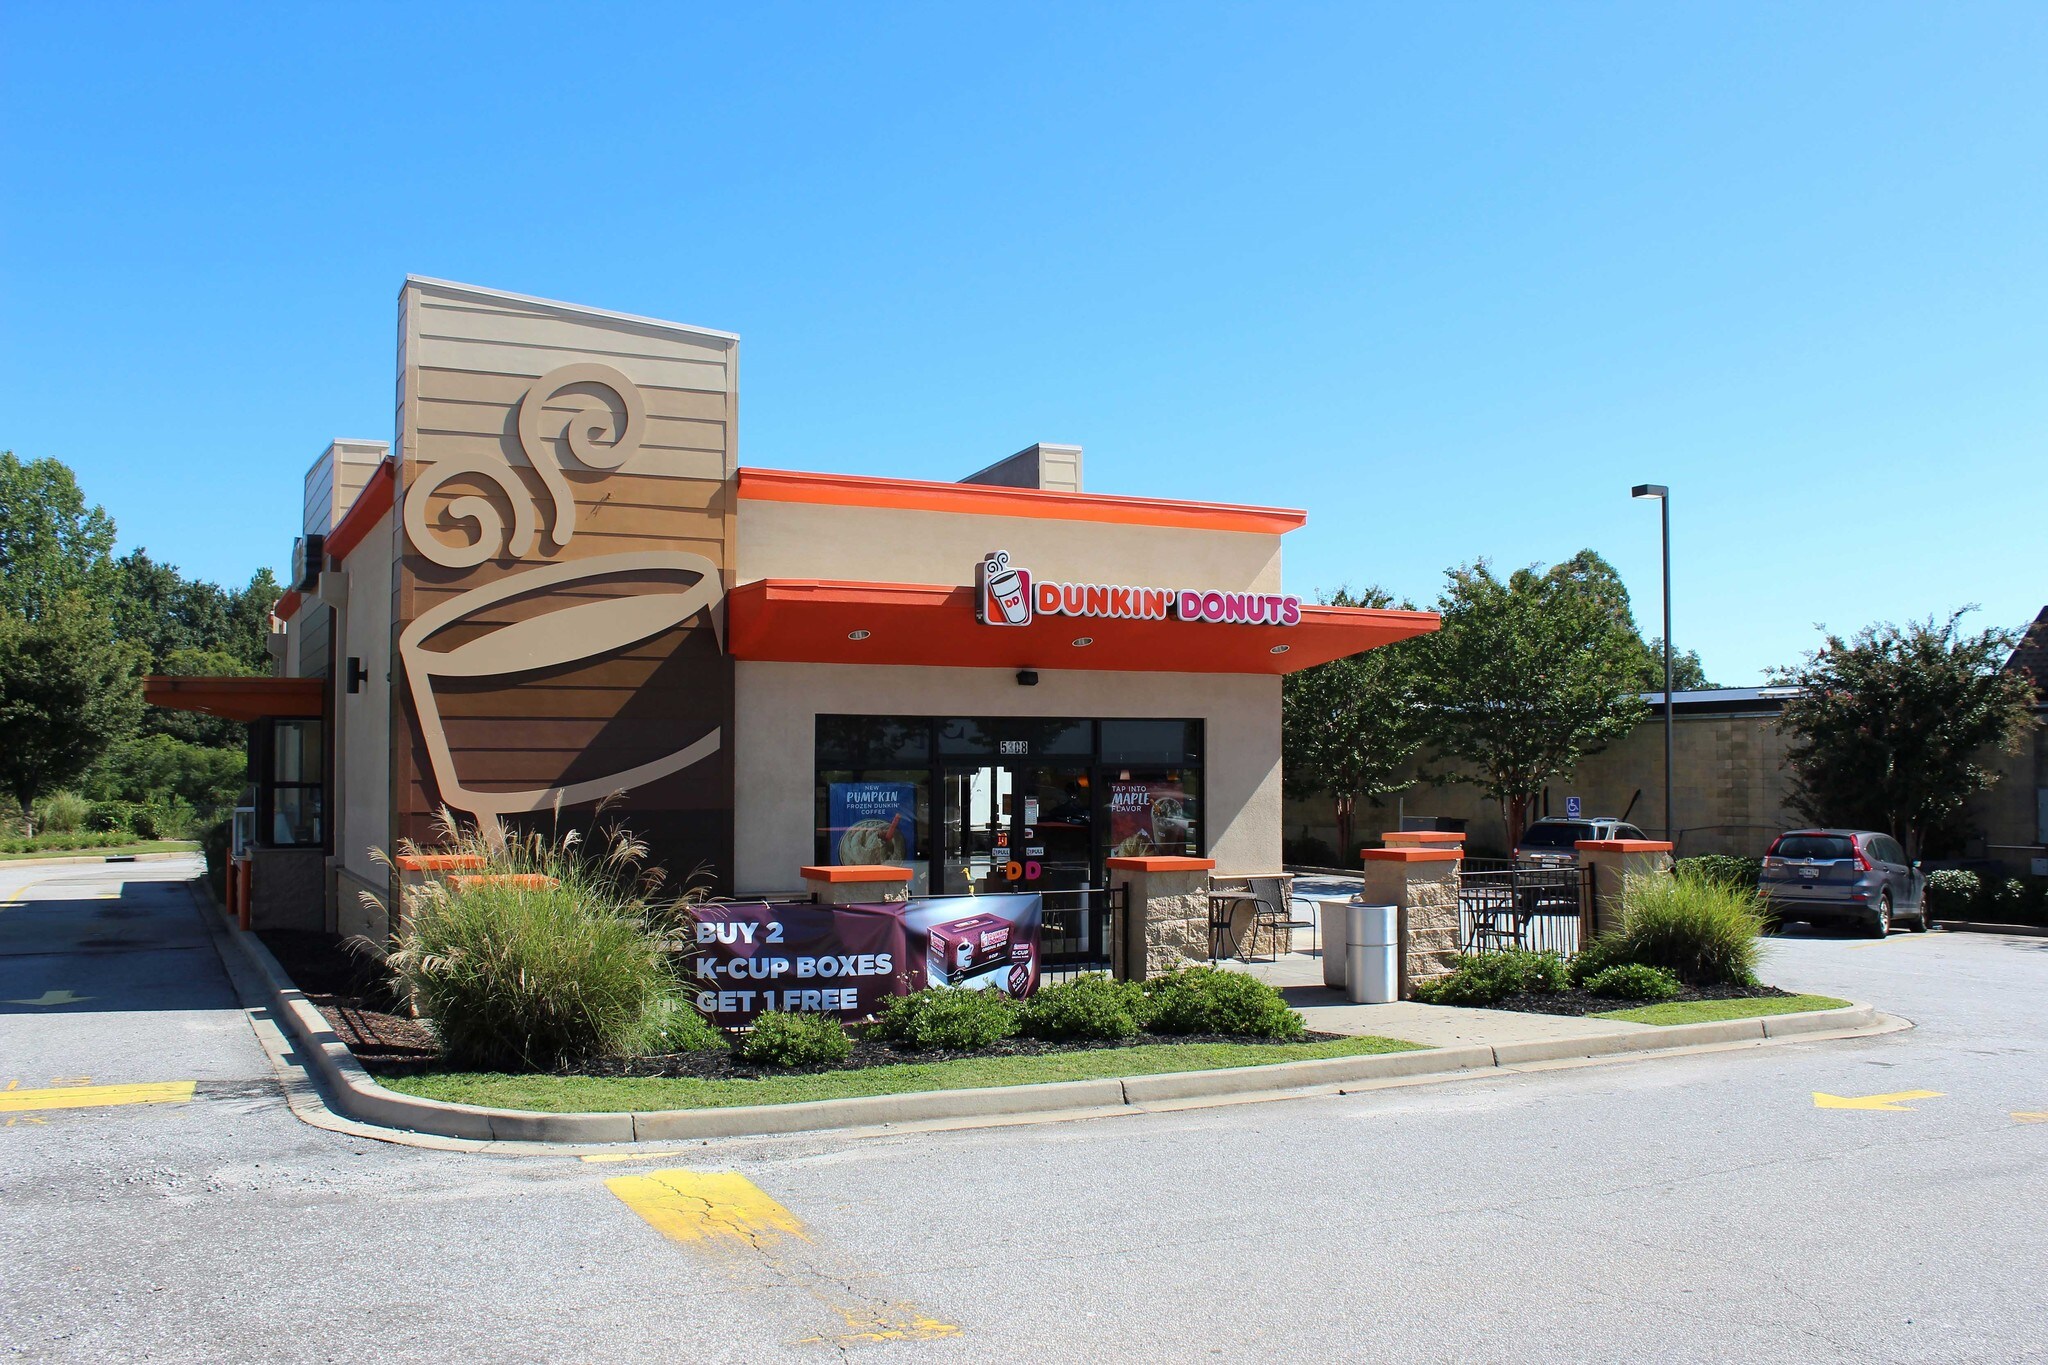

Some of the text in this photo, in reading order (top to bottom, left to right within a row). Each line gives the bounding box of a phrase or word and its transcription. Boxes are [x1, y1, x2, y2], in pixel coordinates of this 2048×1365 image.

[1004, 596, 1020, 609] DD
[1038, 584, 1300, 623] DUNKIN' DONUTS
[846, 791, 898, 803] PUMPKIN
[1112, 792, 1150, 805] MAPLE
[697, 921, 784, 944] BUY 2
[696, 953, 893, 980] K-CUP BOXES
[696, 988, 858, 1013] GET 1 FREE
